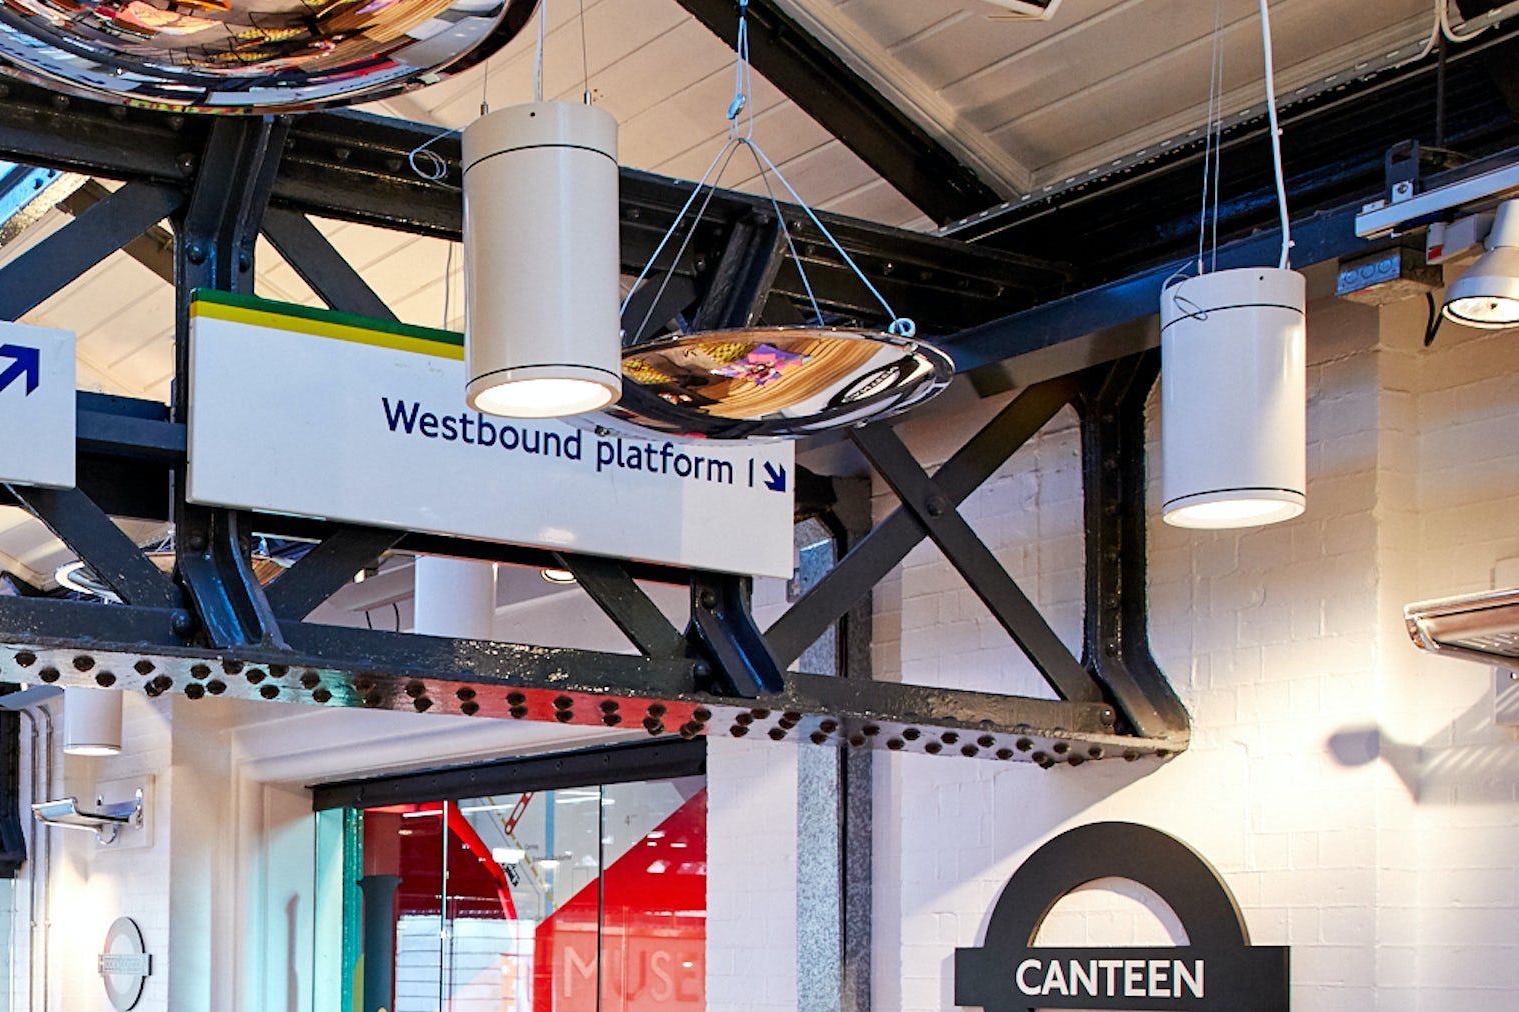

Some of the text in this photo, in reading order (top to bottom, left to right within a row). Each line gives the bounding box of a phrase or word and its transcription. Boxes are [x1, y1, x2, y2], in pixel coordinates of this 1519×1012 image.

[382, 397, 582, 461] Westbound
[596, 437, 733, 485] platform
[563, 945, 705, 1002] MUSE
[1015, 958, 1205, 998] CANTEEN
